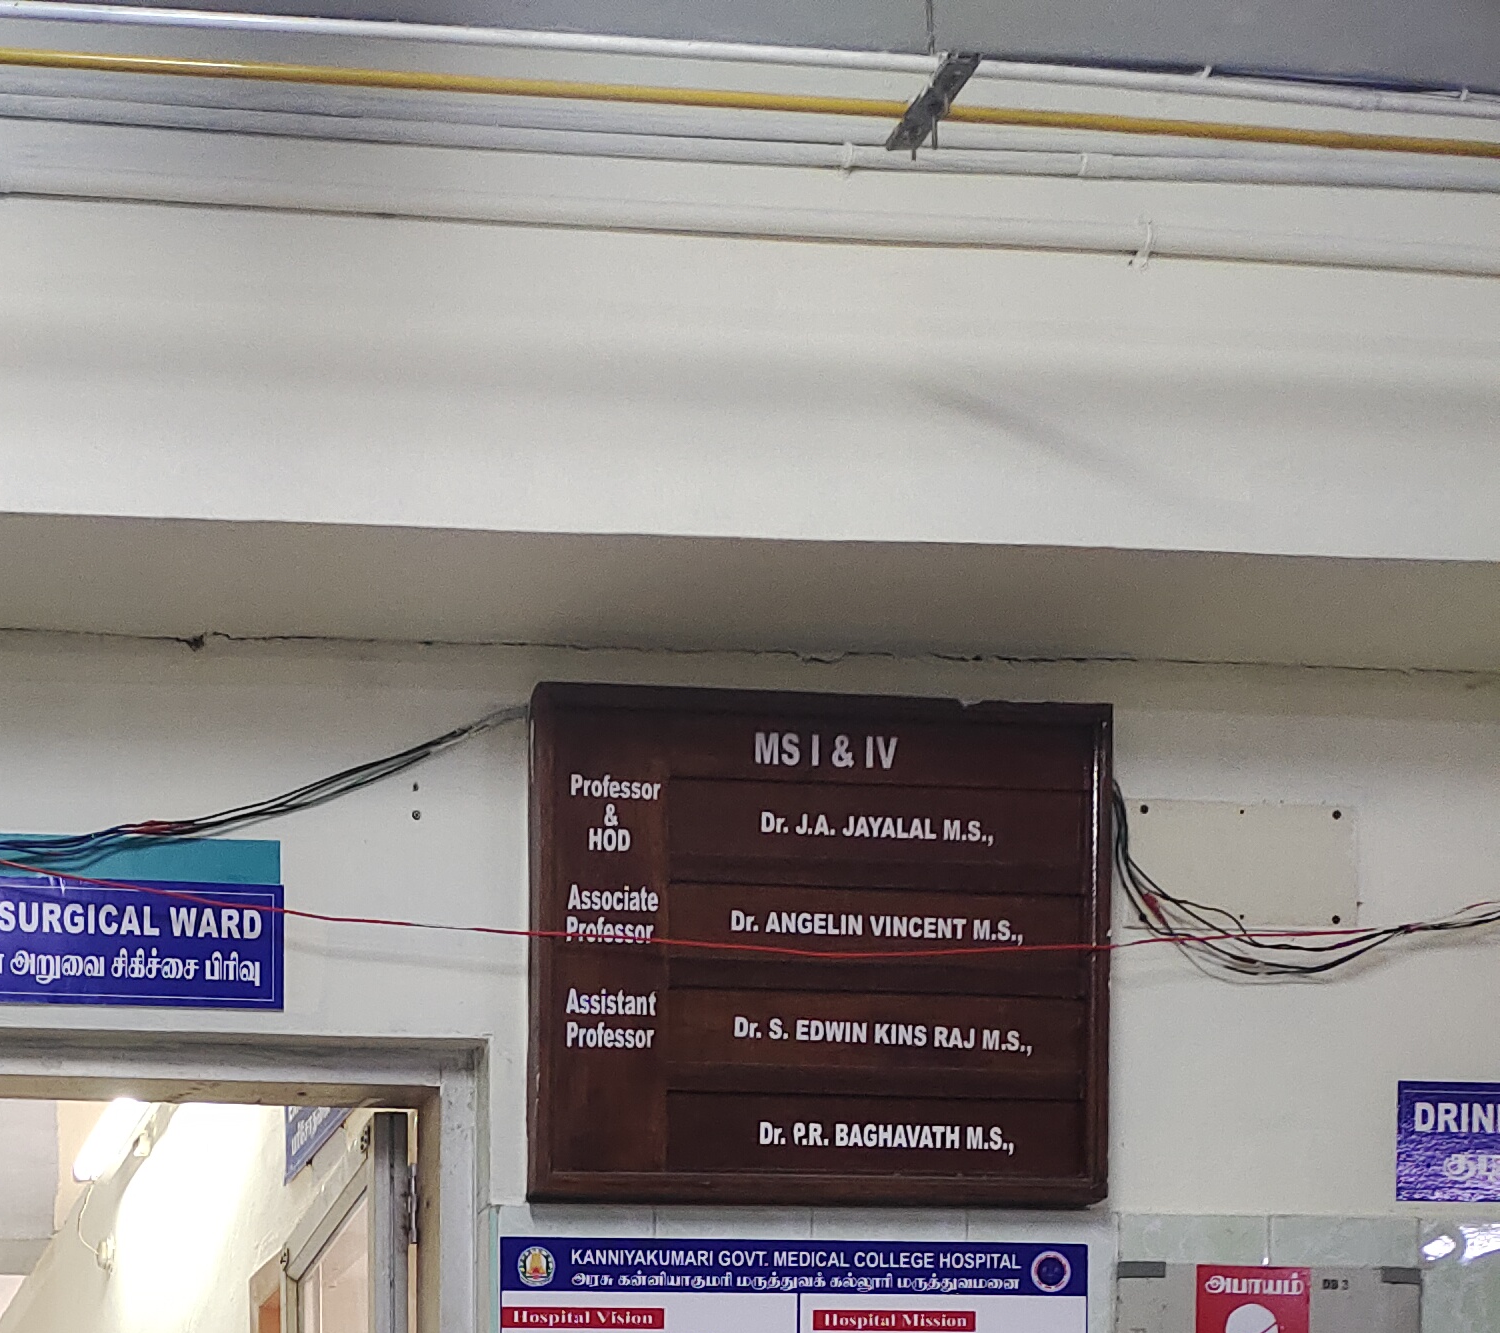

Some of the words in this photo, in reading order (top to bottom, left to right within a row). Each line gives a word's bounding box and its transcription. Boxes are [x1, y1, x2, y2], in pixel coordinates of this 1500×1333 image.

[755, 733, 800, 765] MS
[812, 735, 819, 766] I
[832, 736, 854, 767] &
[866, 736, 897, 768] IV
[571, 774, 661, 800] Professor
[604, 805, 618, 826] &
[588, 829, 631, 852] HOD
[761, 813, 789, 834] Dr.
[796, 815, 835, 836] J.A.
[843, 817, 936, 840] JAYALAL
[943, 821, 994, 845] M.S.,
[568, 886, 659, 911] Associate
[168, 908, 262, 939] WARD
[566, 916, 653, 943] Professor
[731, 911, 759, 932] Dr.
[766, 912, 863, 935] ANGELIN
[870, 915, 966, 940] VINCENT
[973, 919, 1023, 945] M.S.,
[11, 951, 105, 985] அறுவை
[111, 948, 198, 980] சிகிச்சை
[205, 951, 260, 987] பிரிவு
[566, 989, 656, 1017] Assistant
[567, 1022, 654, 1048] Professor
[734, 1017, 762, 1039] Dr.
[770, 1019, 789, 1040] S.
[796, 1020, 867, 1044] EDWIN
[874, 1024, 927, 1047] KINS
[934, 1026, 975, 1049] RAJ
[982, 1030, 1032, 1055] M.S.,
[1414, 1102, 1500, 1132] DRIN
[760, 1123, 787, 1144] Dr.
[794, 1124, 829, 1145] P.R.
[836, 1125, 959, 1149] BAGHAVATH
[966, 1128, 1014, 1154] M.S.,
[571, 1249, 712, 1266] KANNIYAKUMARI
[718, 1250, 768, 1266] GOVT.
[772, 1250, 850, 1267] MEDICAL
[854, 1252, 934, 1268] COLLEGE
[939, 1253, 1021, 1269] HOSPITAL
[571, 1273, 613, 1286] அரசு
[618, 1271, 732, 1288] கன்னியாகுமரி
[739, 1273, 827, 1294] மருத்துவக்
[830, 1273, 893, 1292] கல்லூரி
[897, 1274, 1019, 1292] மருத்துவமனை
[1205, 1272, 1306, 1295] அபாயம்
[513, 1311, 590, 1326] Hospital
[597, 1311, 652, 1324] Vision
[824, 1314, 896, 1329] Hospital
[902, 1314, 967, 1327] Mission
